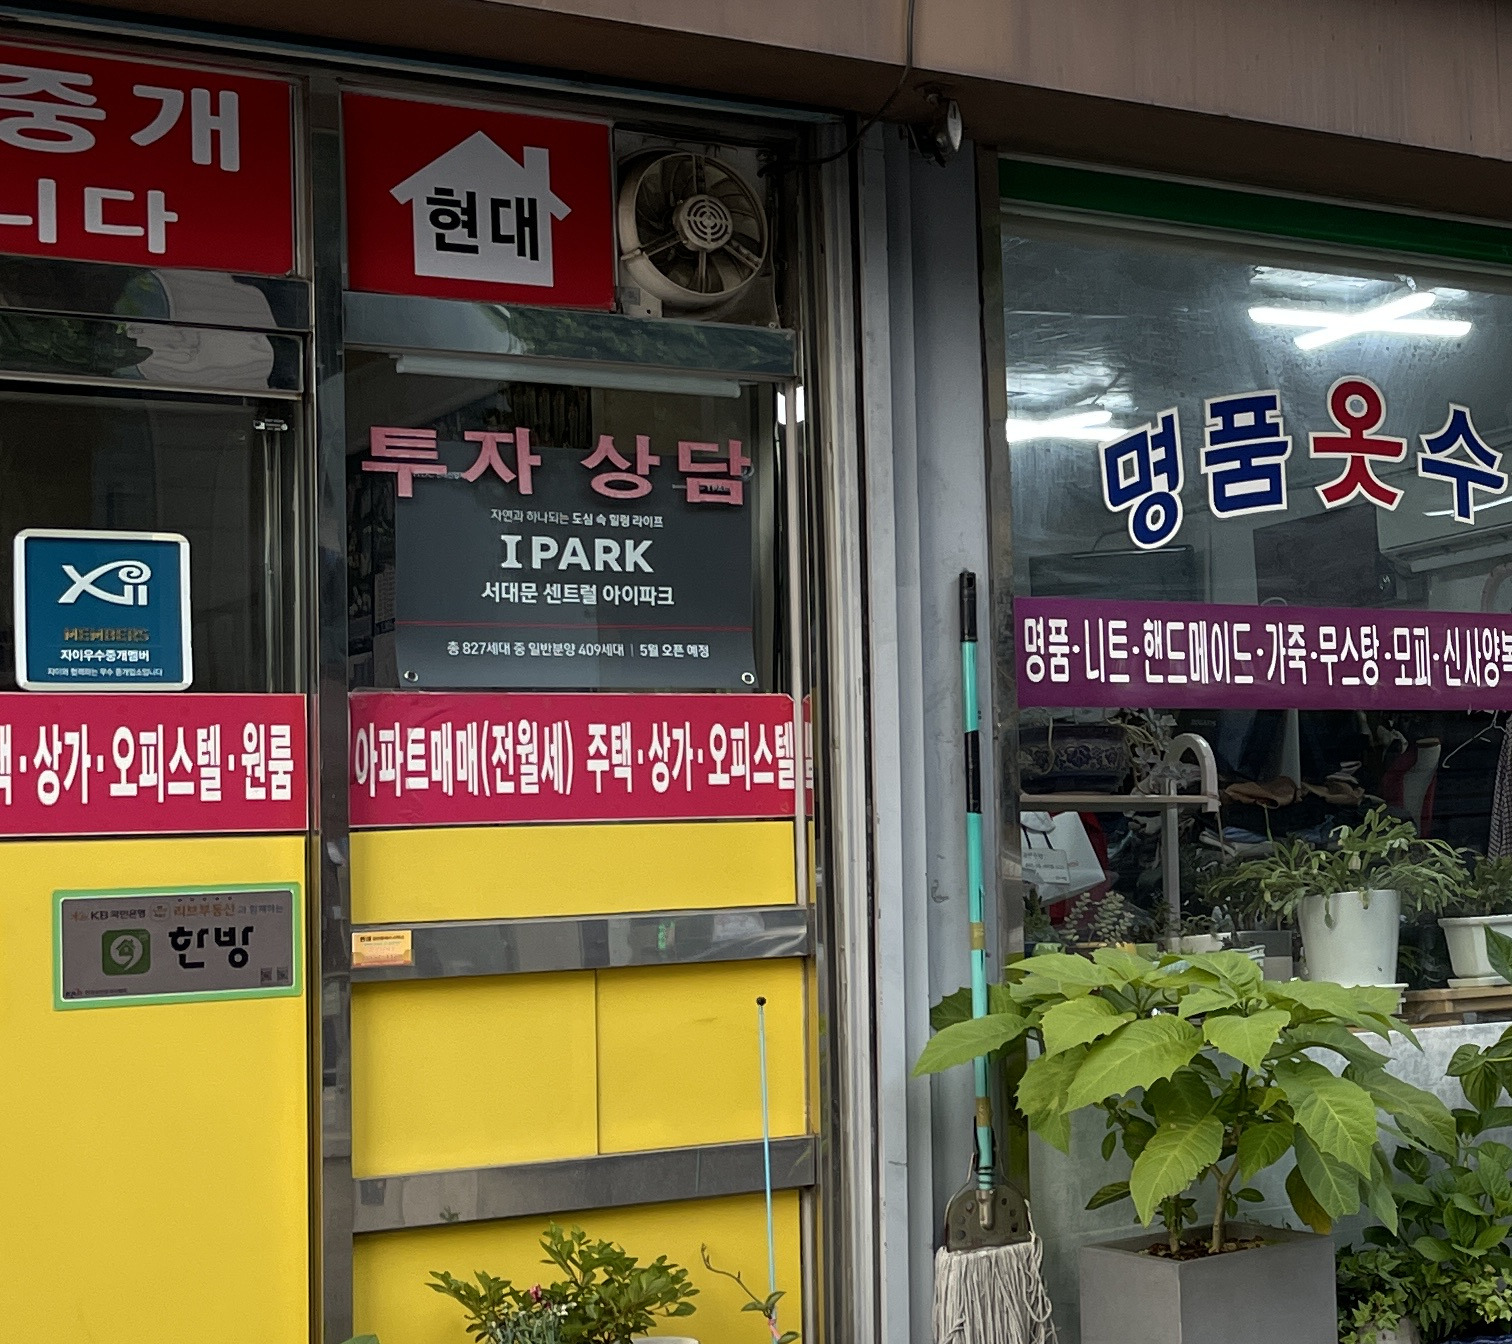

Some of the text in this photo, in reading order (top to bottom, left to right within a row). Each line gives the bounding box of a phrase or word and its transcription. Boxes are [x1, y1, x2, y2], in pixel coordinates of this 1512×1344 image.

[0, 63, 240, 172] 중개
[425, 185, 542, 262] 현대
[361, 426, 752, 506] 투자 상담
[490, 508, 524, 523] 자연과
[526, 510, 570, 525] 하나되는
[572, 512, 594, 526] 도심
[632, 515, 664, 529] 라이프
[481, 583, 675, 607] 서대문 센트럴 아이파크
[447, 641, 460, 656] 총
[462, 642, 511, 656] 827세대
[528, 642, 576, 656] 일반분양
[578, 642, 625, 657] 409세대
[640, 643, 659, 658] 5월
[662, 643, 685, 658] 오픈
[686, 643, 710, 658] 예정
[168, 925, 255, 969] 한방
